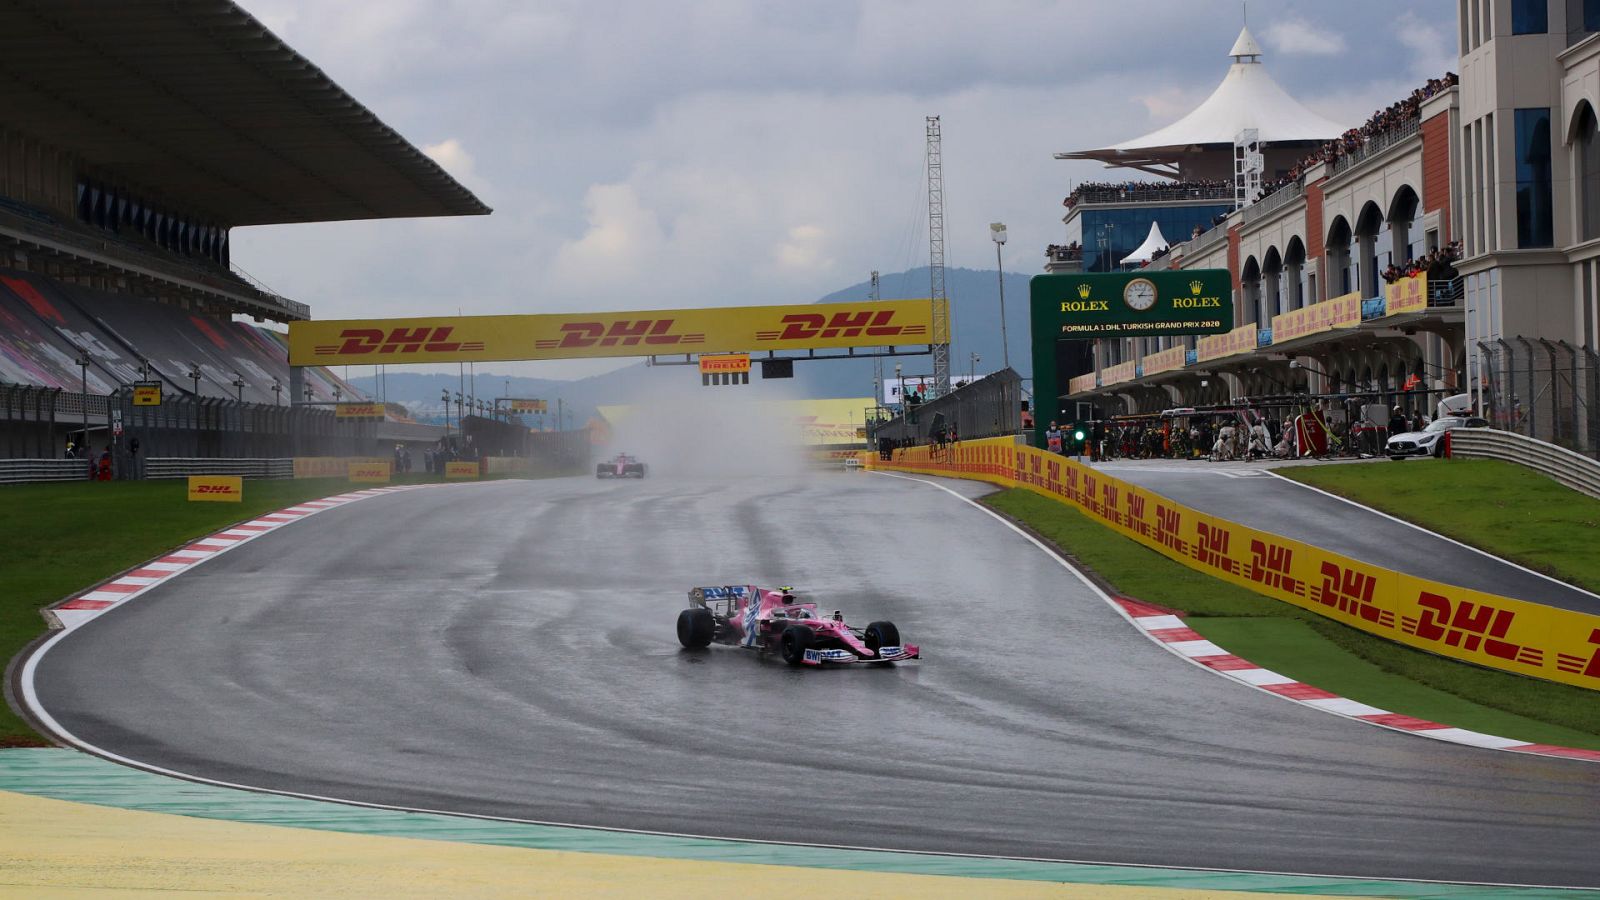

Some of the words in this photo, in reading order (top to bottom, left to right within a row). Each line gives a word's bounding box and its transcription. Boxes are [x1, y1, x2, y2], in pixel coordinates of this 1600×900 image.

[1060, 301, 1109, 312] ROLEX
[1172, 297, 1221, 309] ROLEX
[337, 326, 461, 354] DHL
[558, 319, 683, 348] DHL
[779, 310, 903, 340] DHL
[702, 359, 747, 370] PIRELLI
[196, 485, 233, 494] DHL
[1083, 473, 1100, 513] DHL
[1103, 483, 1121, 524] DHL
[1127, 492, 1148, 536] DHL
[1156, 504, 1184, 553] DHL
[1197, 521, 1233, 573] DHL
[1250, 539, 1296, 594] DHL
[1320, 560, 1381, 624] DHL
[1415, 591, 1521, 661] DHL
